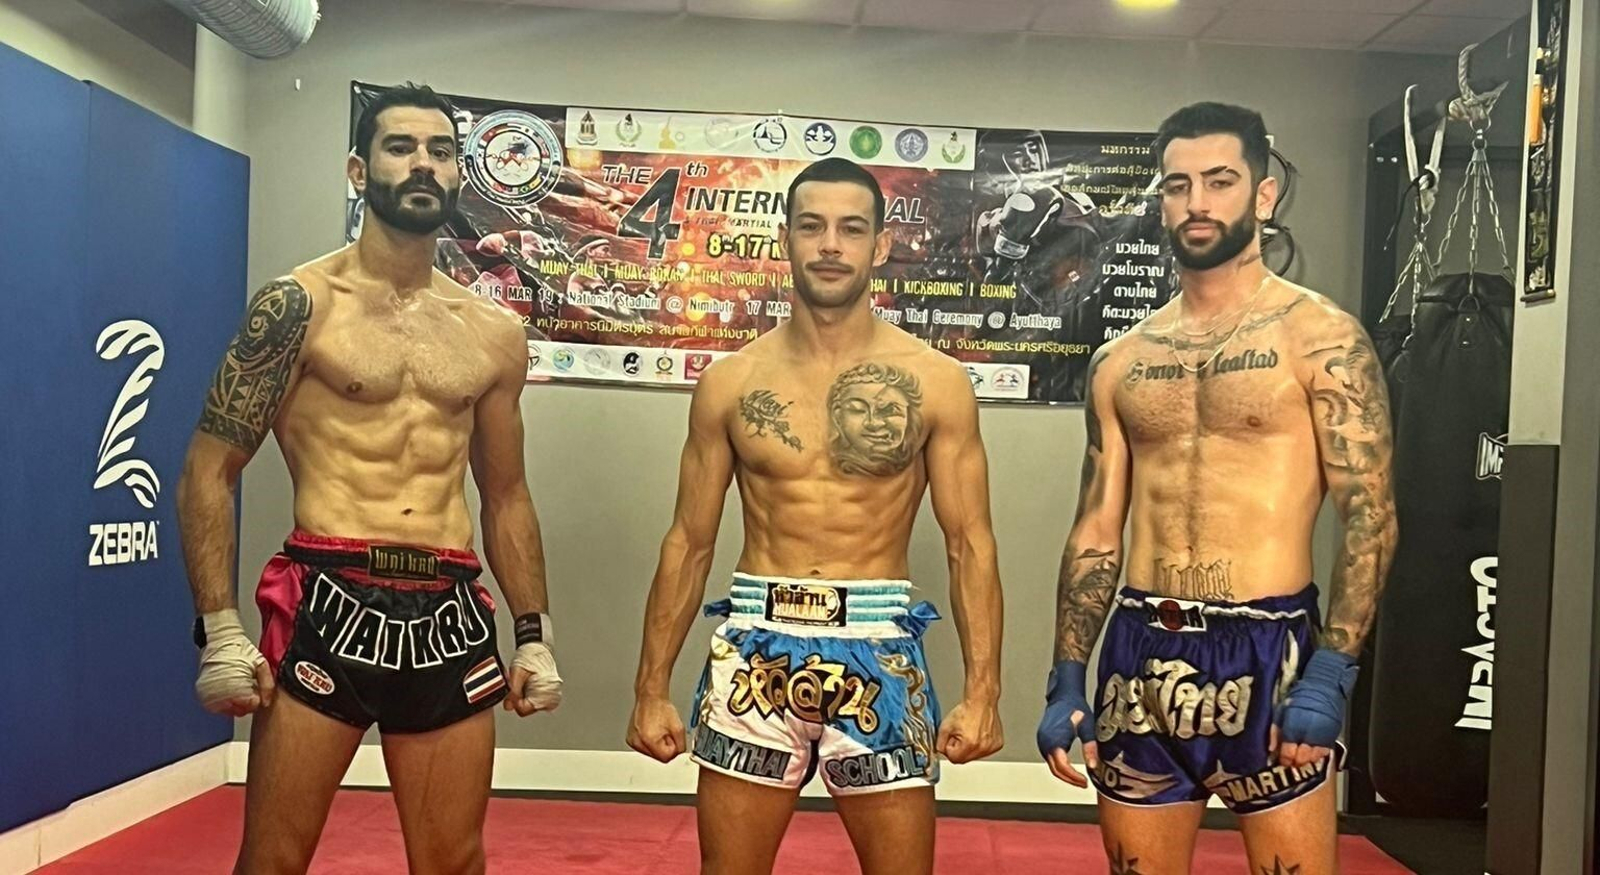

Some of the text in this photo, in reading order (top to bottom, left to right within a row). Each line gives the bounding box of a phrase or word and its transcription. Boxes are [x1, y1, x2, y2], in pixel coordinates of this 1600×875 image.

[602, 161, 708, 260] THE 4 th
[727, 217, 772, 229] MARTIAL
[1115, 238, 1160, 256] มวยไทย
[540, 259, 568, 274] MUAY
[576, 262, 598, 278] THAI
[614, 265, 642, 281] MUAY
[702, 269, 725, 285] THAI
[729, 272, 766, 287] SWORD
[868, 278, 887, 293] HAI
[903, 280, 964, 297] KICKBOXING
[980, 283, 1017, 299] BOXING
[1102, 259, 1165, 277] มวยโบราณ
[508, 286, 532, 301] MAR
[569, 291, 611, 307] National
[618, 293, 660, 310] Stadium
[746, 300, 761, 315] 17
[766, 301, 793, 317] MAR
[905, 307, 928, 324] Thai
[1009, 313, 1062, 331] Ayutthaya
[1113, 281, 1157, 299] ดาบไทย
[89, 521, 158, 566] ZEBRA
[825, 745, 925, 787] SCHOOL
